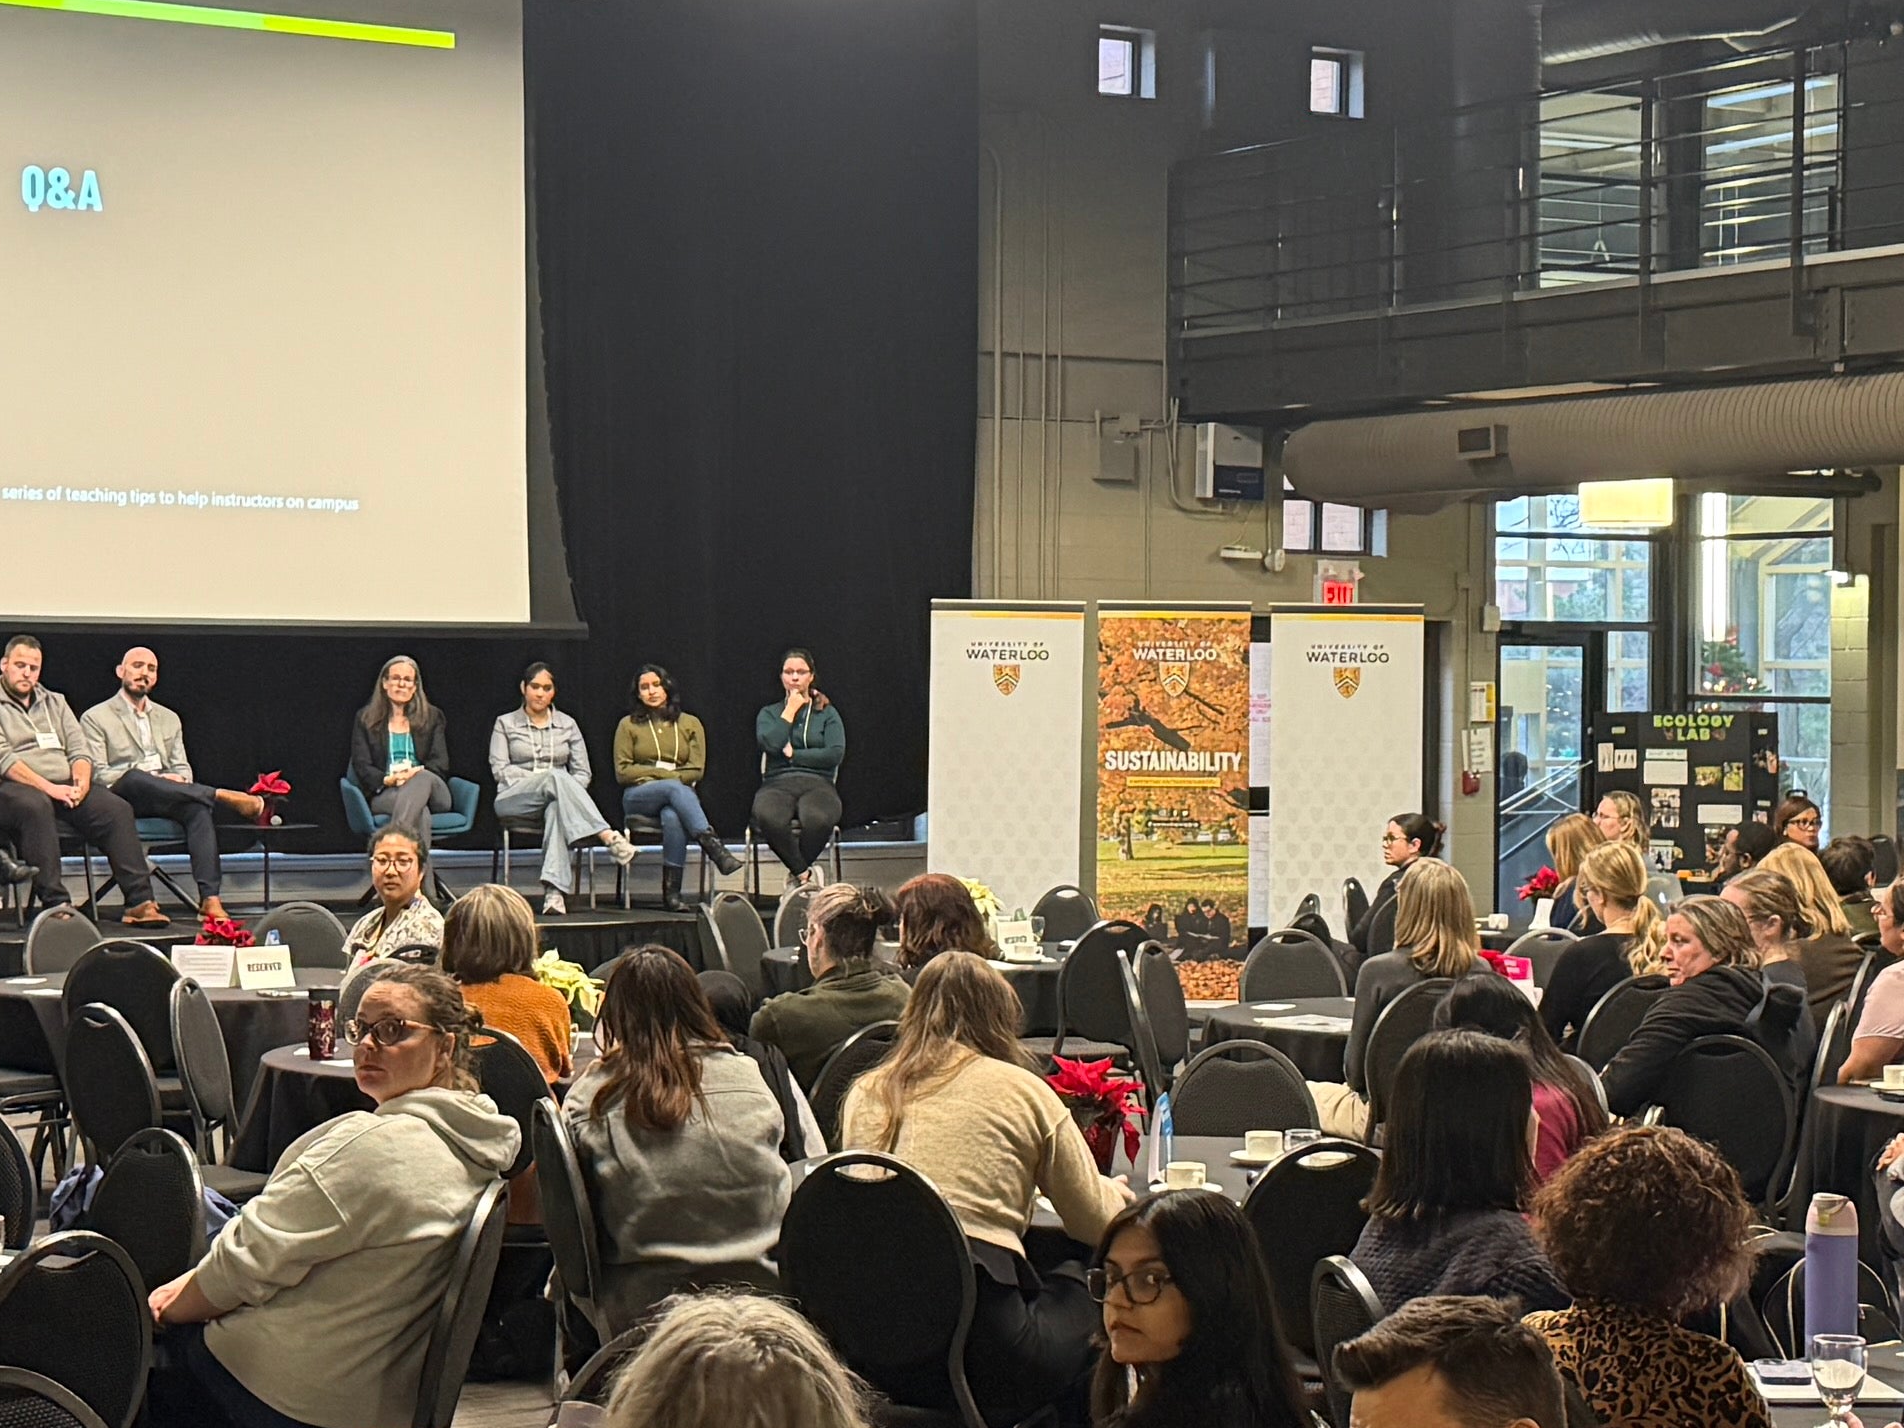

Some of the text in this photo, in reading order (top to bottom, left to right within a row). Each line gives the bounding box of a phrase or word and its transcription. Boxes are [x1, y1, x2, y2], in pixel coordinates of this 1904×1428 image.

[22, 165, 103, 212] Q&A
[2, 484, 43, 500] series
[46, 486, 62, 500] of
[66, 487, 126, 506] teaching
[130, 489, 156, 506] tips
[159, 490, 174, 504] to
[178, 491, 208, 508] help
[211, 492, 283, 508] instructors
[286, 497, 304, 508] on
[307, 498, 359, 513] campus
[966, 649, 1049, 660] WATERLOO
[1132, 648, 1217, 661] WATERLOO
[1306, 652, 1389, 663] WATERLOO
[1653, 715, 1734, 728] ECOLOGY
[1677, 728, 1710, 740] LAB
[1105, 750, 1242, 772] SUSTAINABILITY
[247, 961, 282, 972] RESERVED
